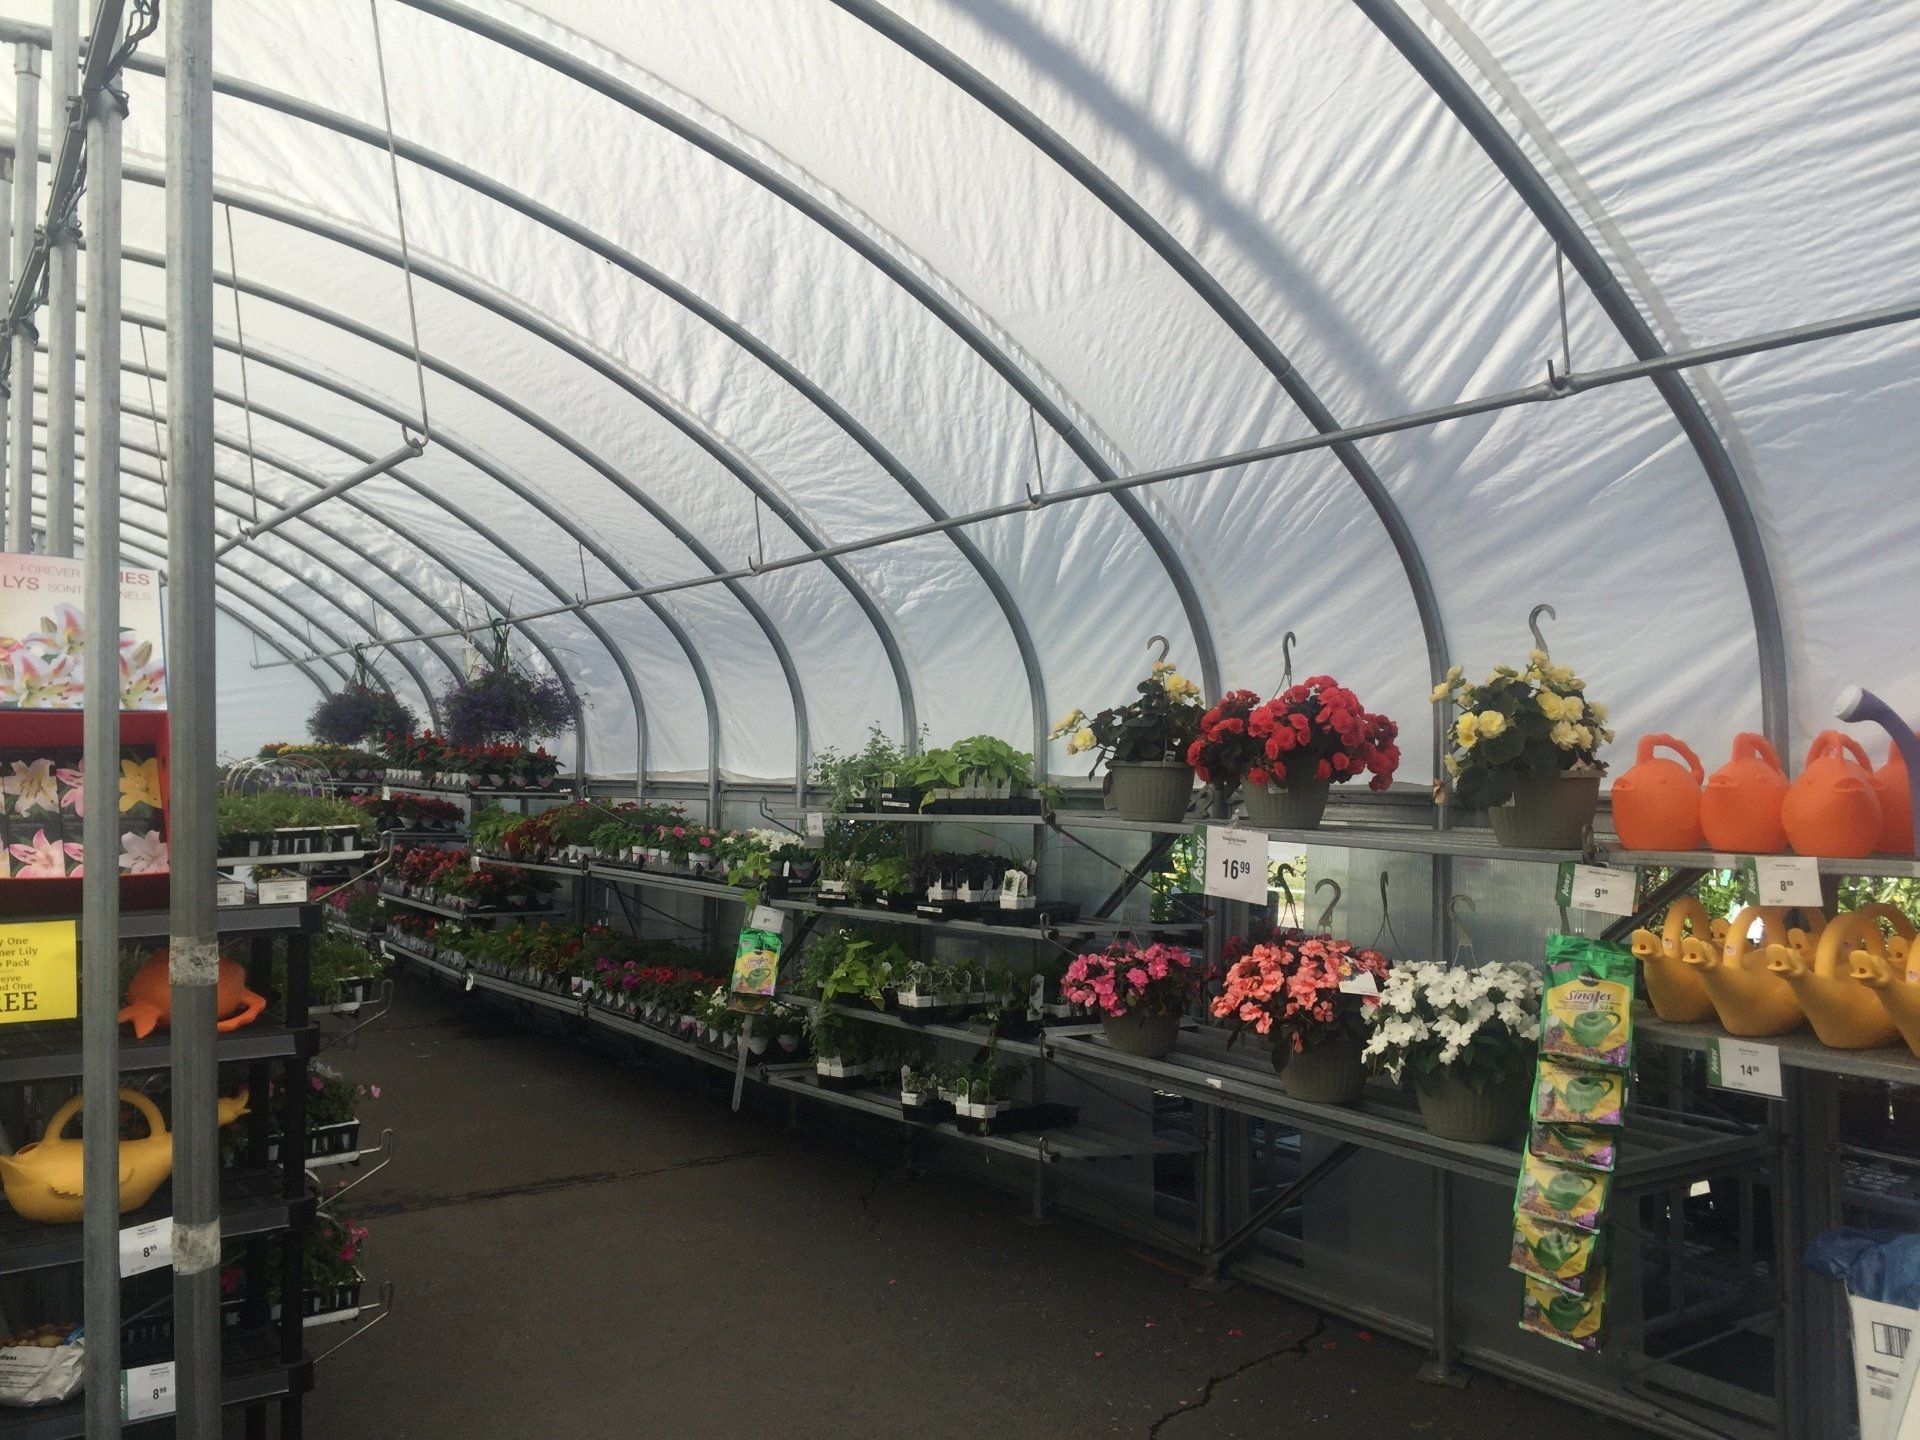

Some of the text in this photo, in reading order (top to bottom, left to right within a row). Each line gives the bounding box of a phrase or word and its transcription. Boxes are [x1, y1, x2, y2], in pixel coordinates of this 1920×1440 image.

[20, 564, 80, 578] FOREVER
[3, 575, 40, 590] LYS
[47, 583, 82, 594] SONT
[1193, 834, 1206, 885] Sobeys
[7, 937, 29, 945] One
[19, 946, 38, 957] Lily
[6, 958, 30, 968] Pack
[12, 982, 33, 991] One
[0, 991, 37, 1012] EE
